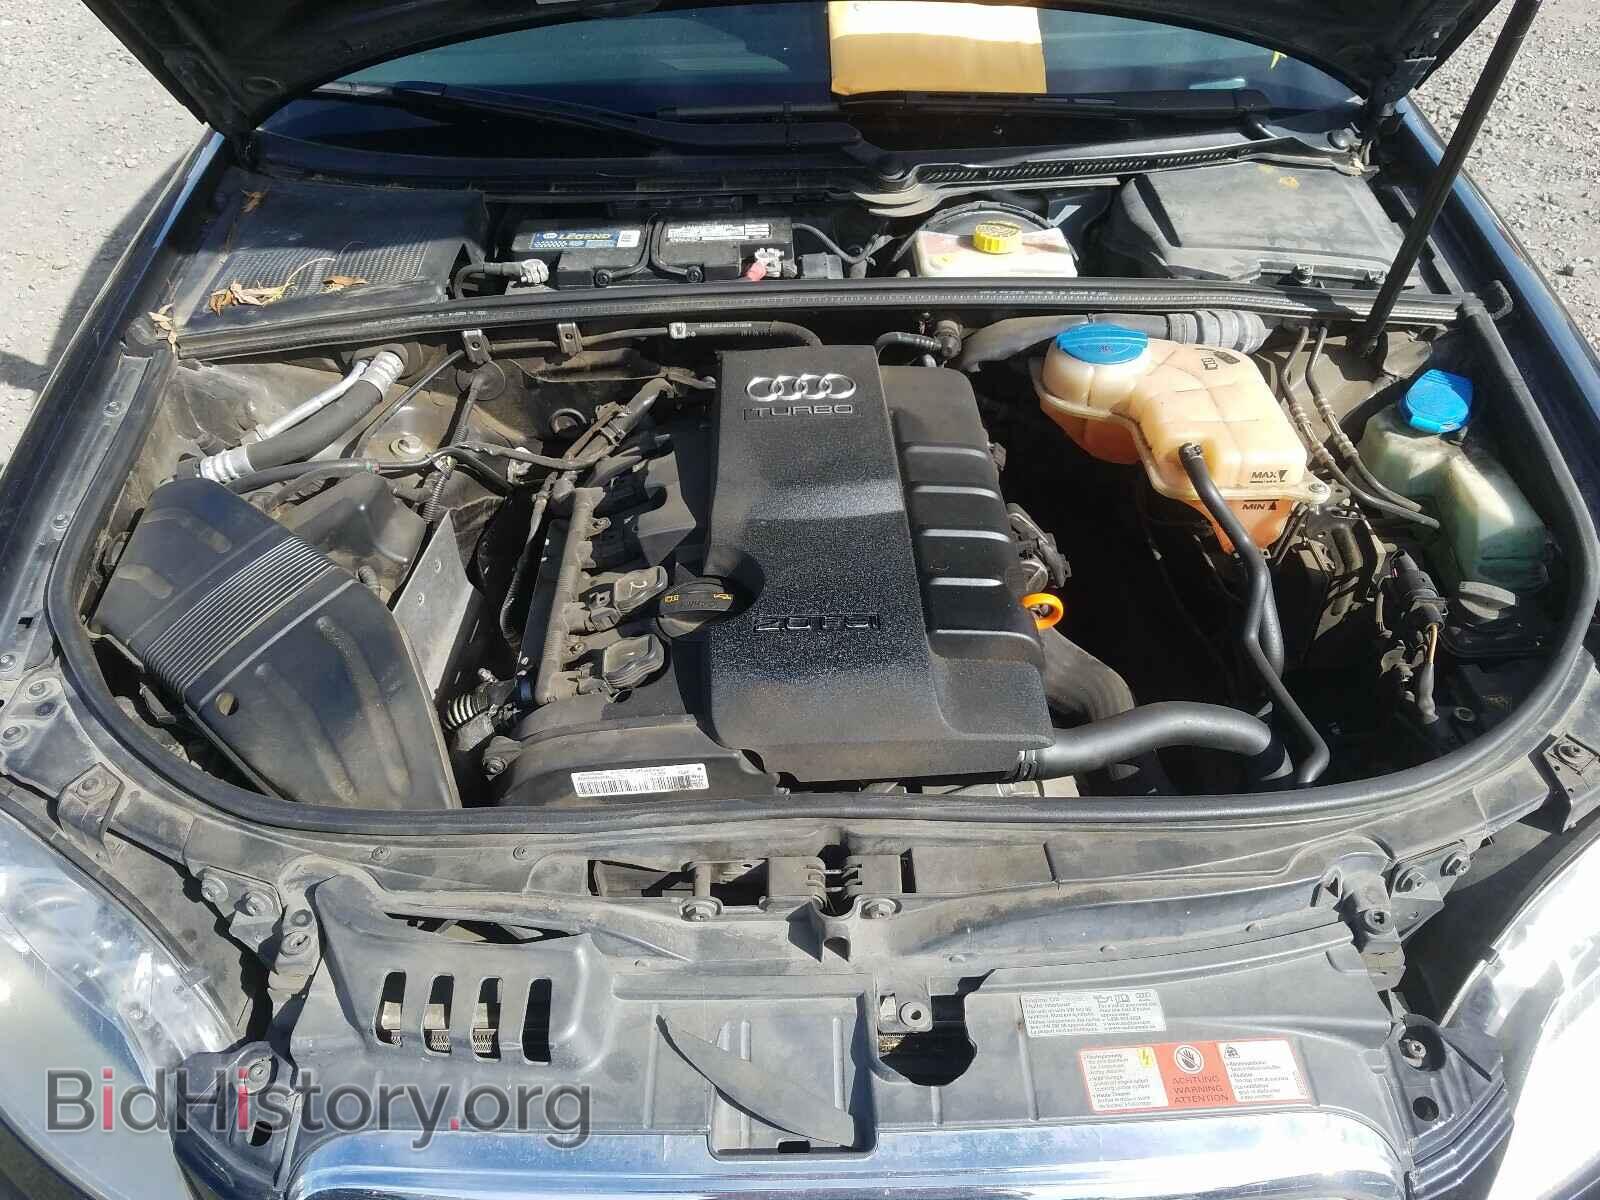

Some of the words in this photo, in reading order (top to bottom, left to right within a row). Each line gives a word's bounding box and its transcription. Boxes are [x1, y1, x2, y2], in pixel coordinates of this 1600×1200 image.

[749, 404, 853, 416] TURBO
[1251, 471, 1277, 479] MAX
[1242, 503, 1266, 511] MIN
[1172, 1074, 1219, 1085] ACHTUNG
[1173, 1084, 1223, 1094] WARNING
[1174, 1094, 1229, 1105] ATTENTION
